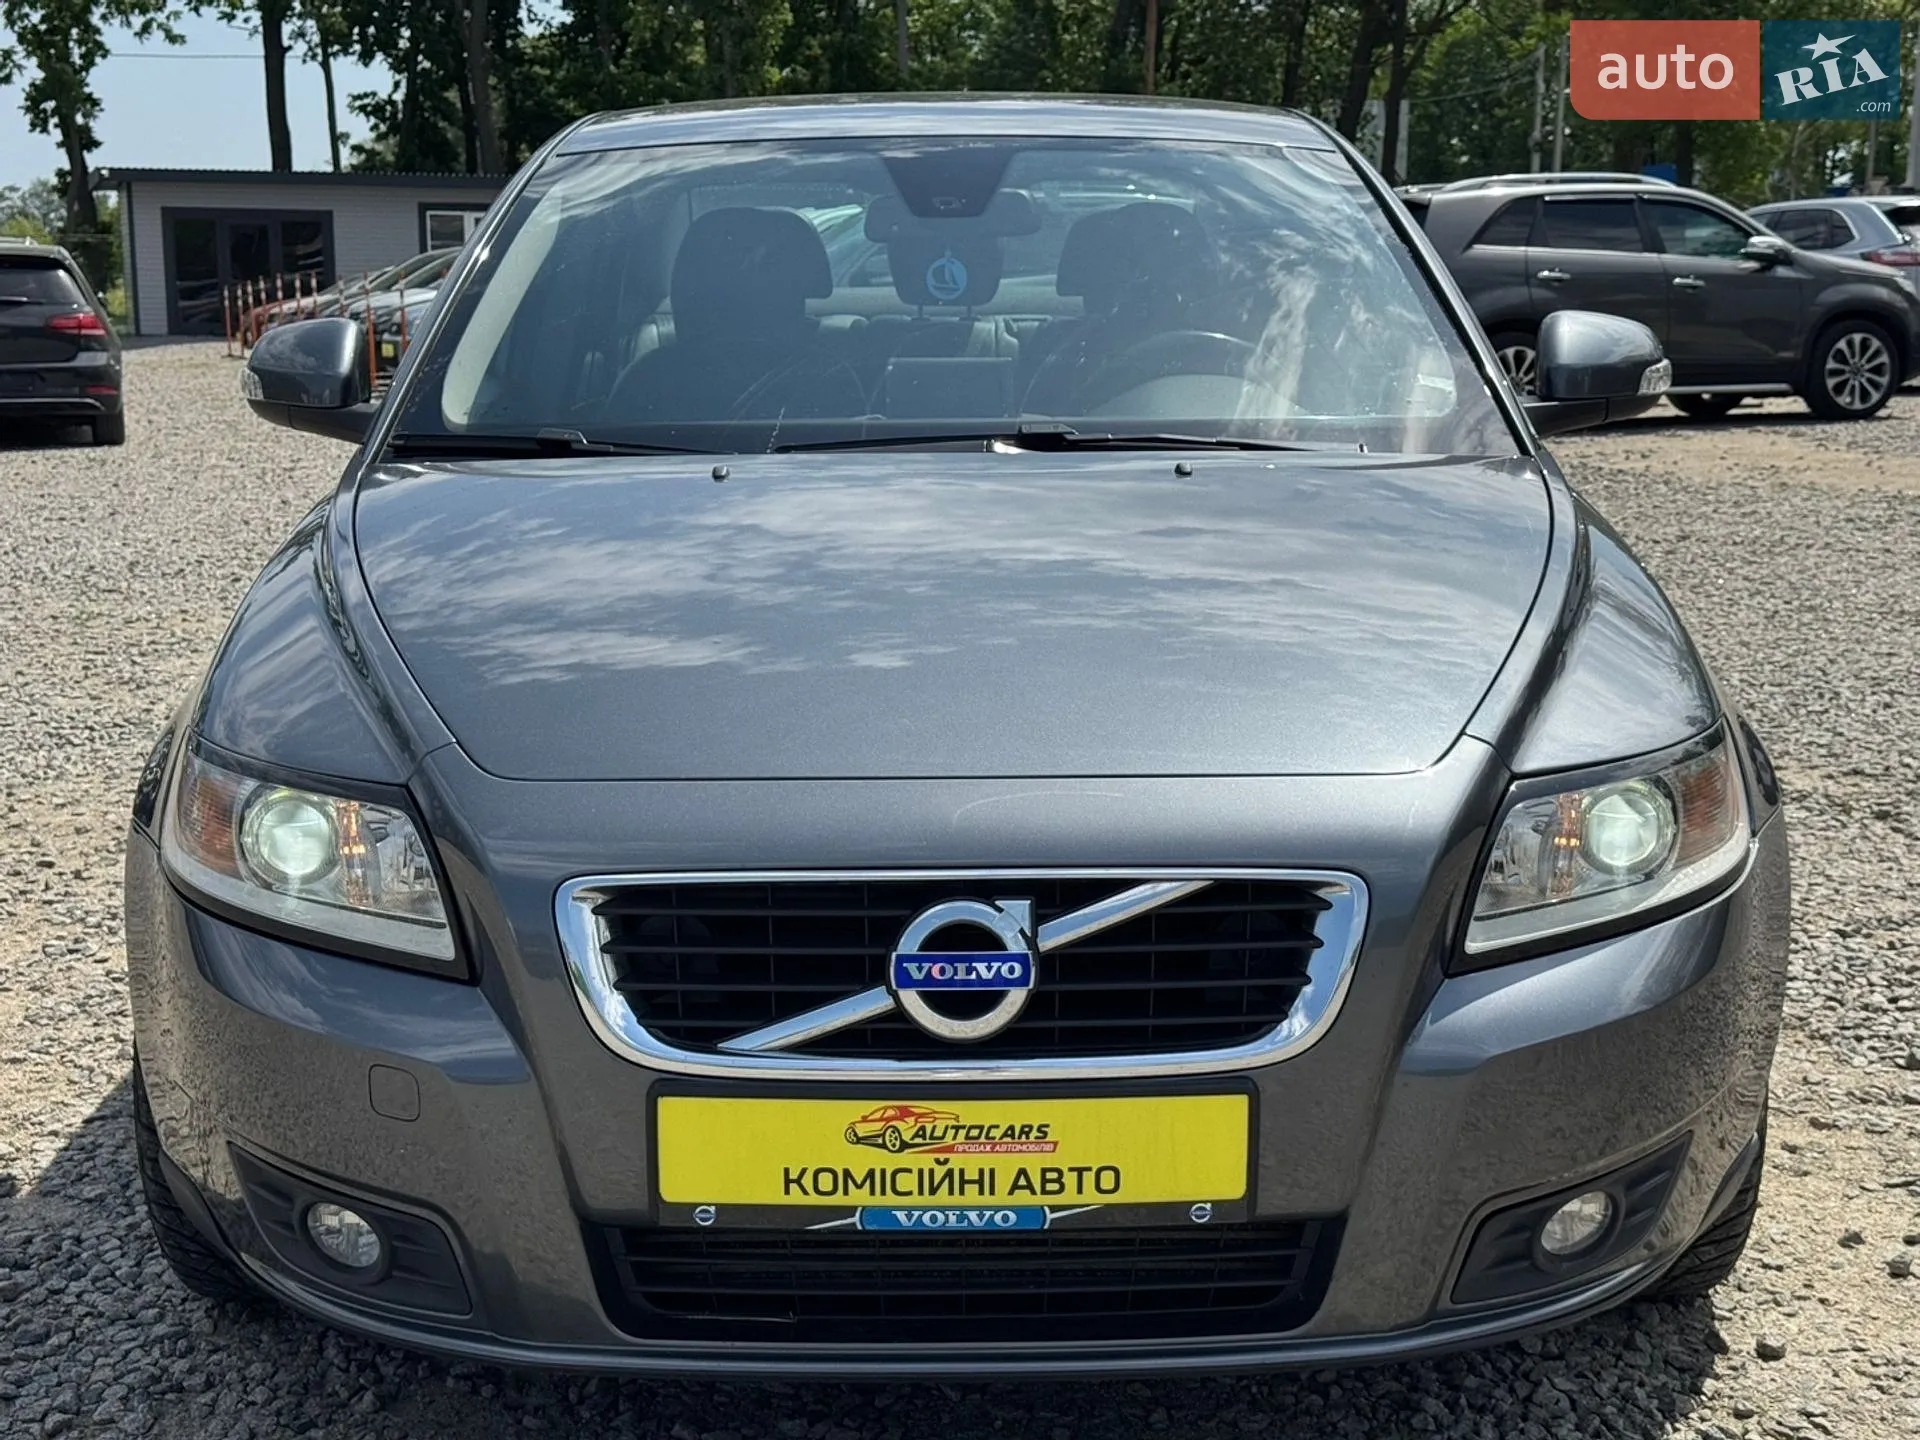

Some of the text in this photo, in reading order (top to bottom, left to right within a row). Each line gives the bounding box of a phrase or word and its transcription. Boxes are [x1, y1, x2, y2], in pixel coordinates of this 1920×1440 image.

[903, 962, 1023, 980] VOLVO
[909, 1123, 1050, 1141] AUTOCARS
[783, 1158, 1121, 1197] КОМІСІЙНІ АВТО
[891, 1210, 1018, 1227] VOLVO
